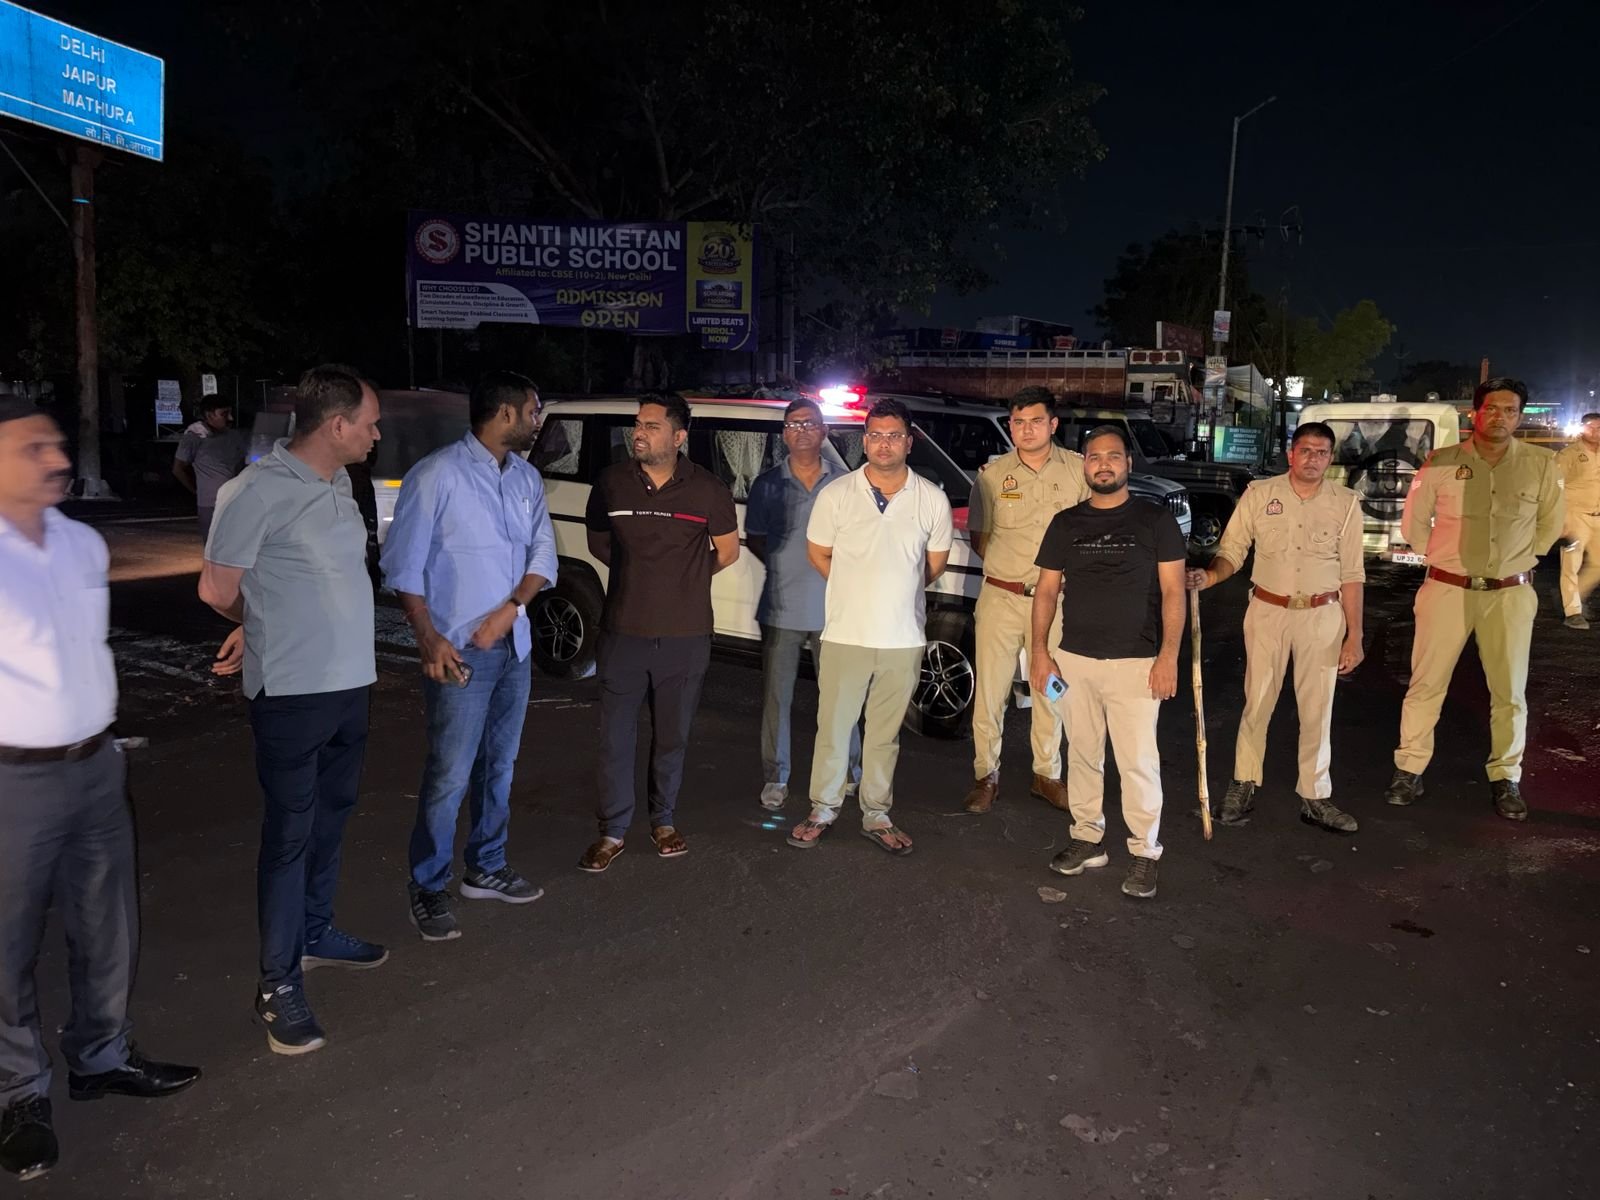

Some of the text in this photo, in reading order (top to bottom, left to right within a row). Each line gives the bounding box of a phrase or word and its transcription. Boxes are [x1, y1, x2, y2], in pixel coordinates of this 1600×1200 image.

[60, 34, 105, 63] DELHI
[62, 64, 117, 94] JAIPUR
[62, 88, 136, 126] MATHURA
[464, 221, 561, 246] SHANTI
[569, 226, 681, 250] NIKETAN
[464, 243, 561, 268] PUBLIC
[568, 248, 678, 272] SCHOOL
[495, 267, 536, 277] Affiliated
[537, 269, 550, 277] to:
[551, 270, 574, 279] CBSE
[607, 272, 628, 280] New
[629, 272, 652, 281] Delhi
[421, 284, 437, 292] WHY
[438, 285, 466, 293] CHOOSE
[556, 288, 664, 308] ADMISSION
[581, 309, 640, 329] OPEN
[692, 317, 744, 326] LIMITED SEATS
[701, 326, 737, 336] ENROLL
[708, 335, 729, 344] NOW
